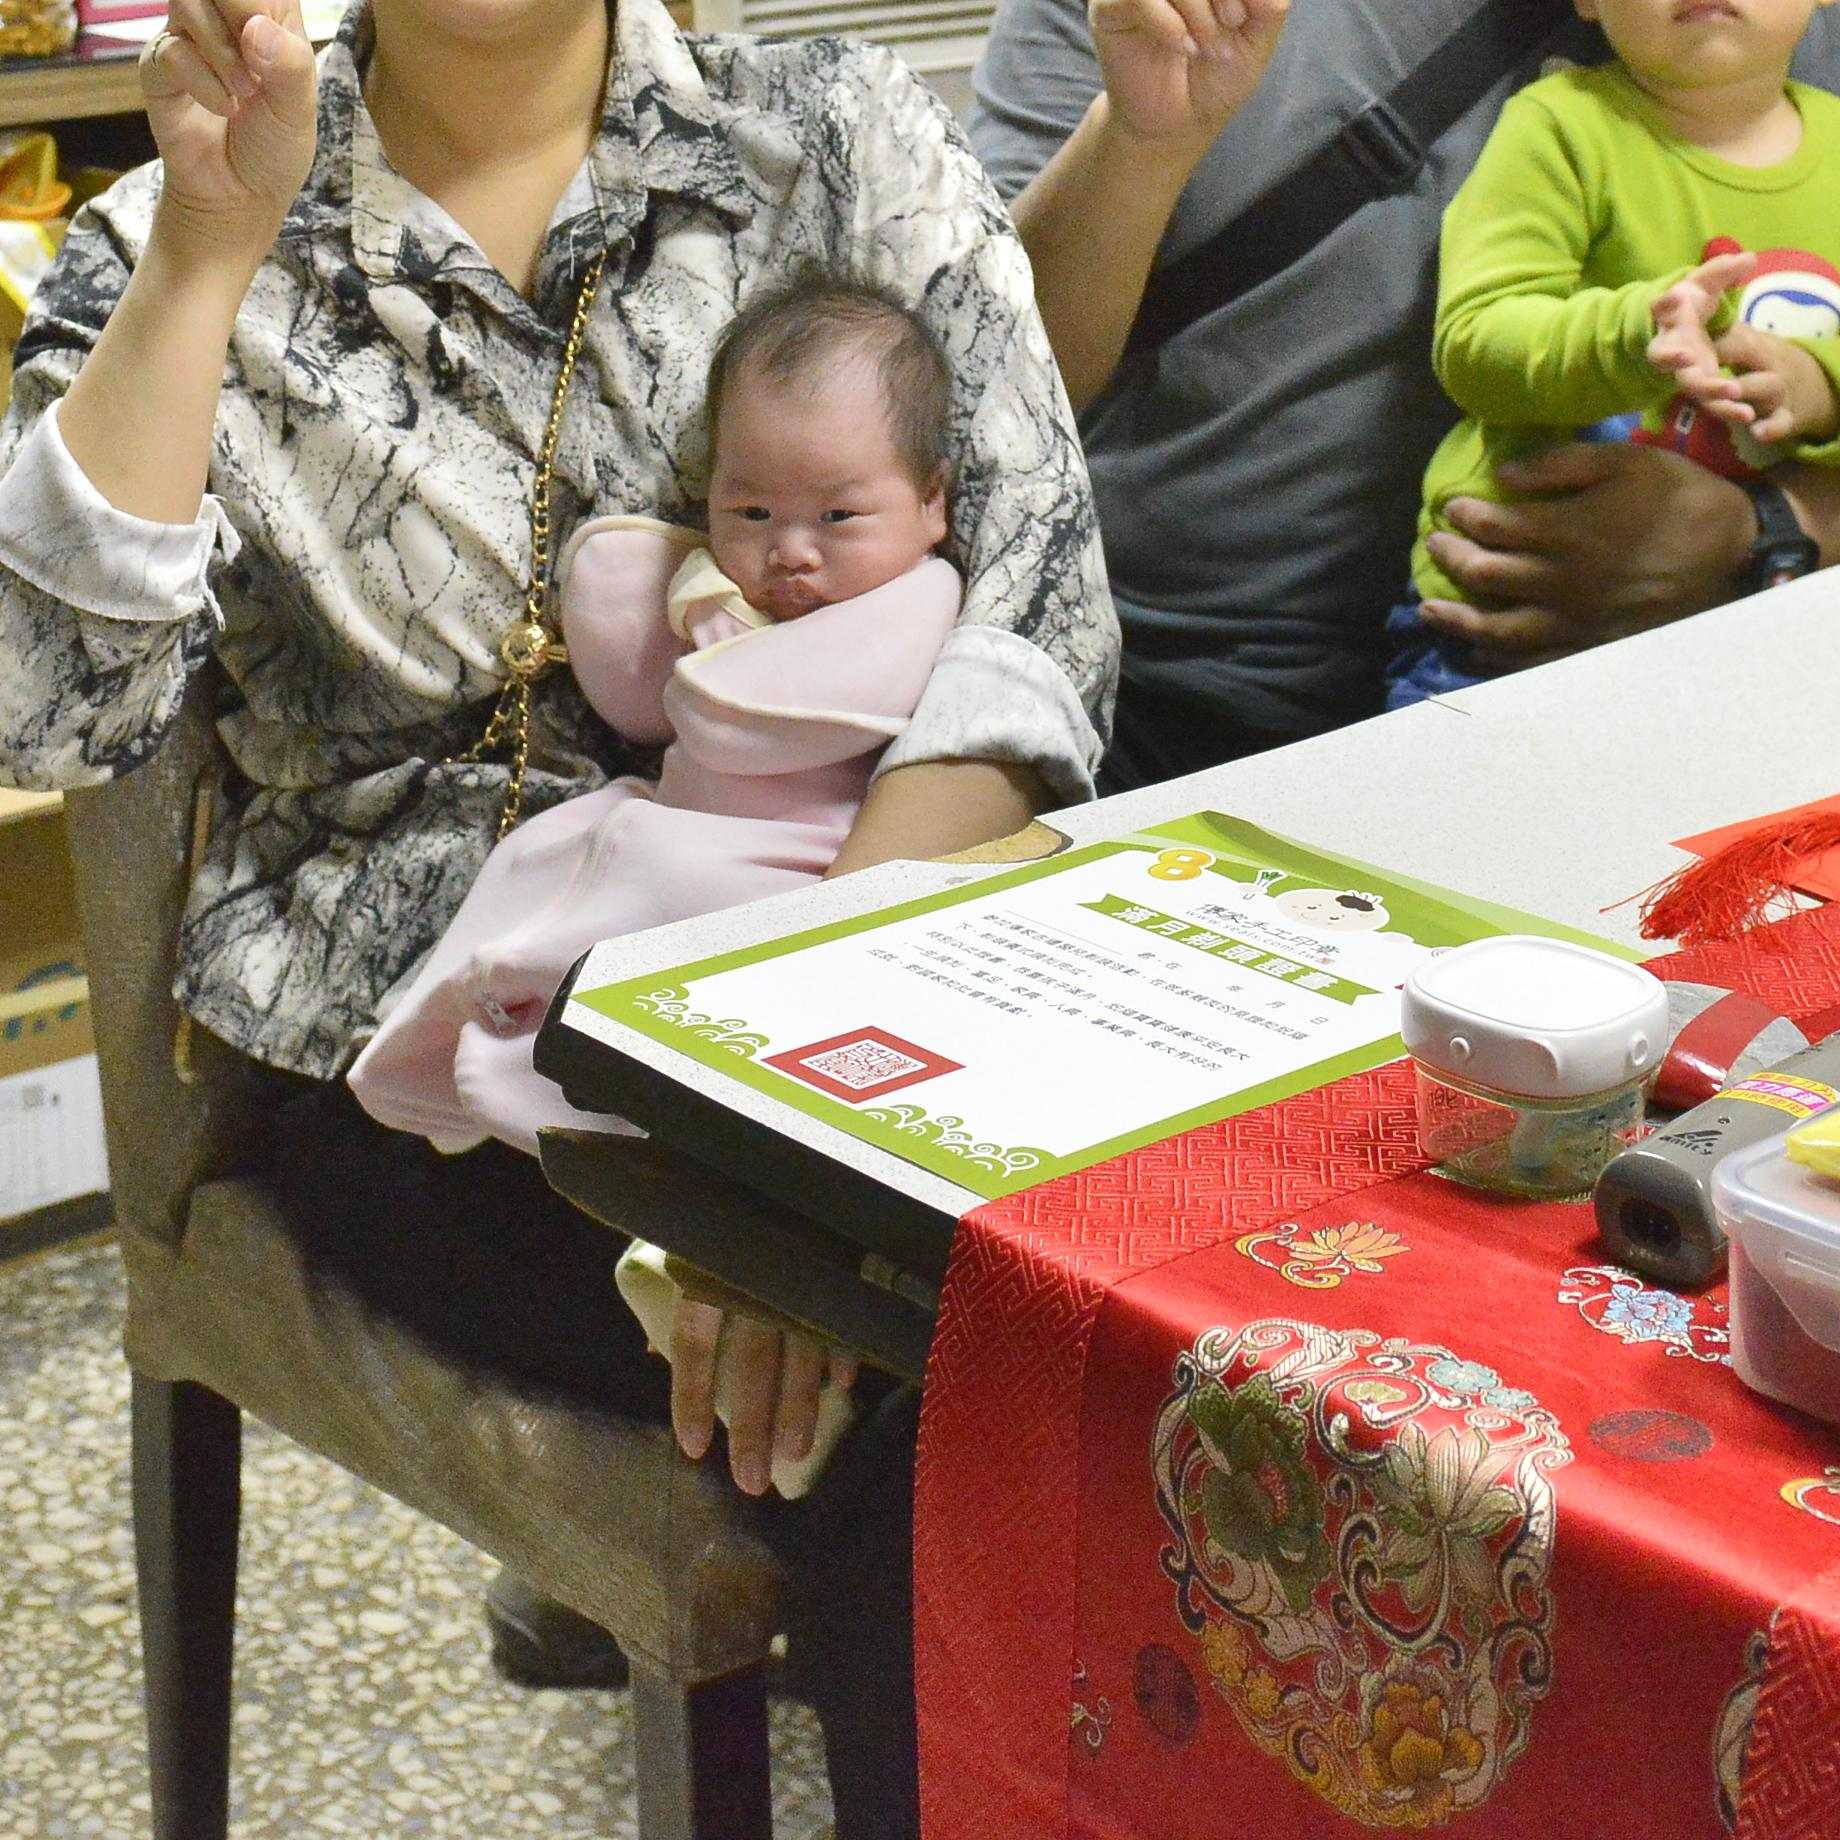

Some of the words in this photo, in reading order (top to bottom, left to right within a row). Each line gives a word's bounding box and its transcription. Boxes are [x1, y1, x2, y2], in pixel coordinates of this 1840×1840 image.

[1112, 905, 1340, 990] 滿月剃頭證書
